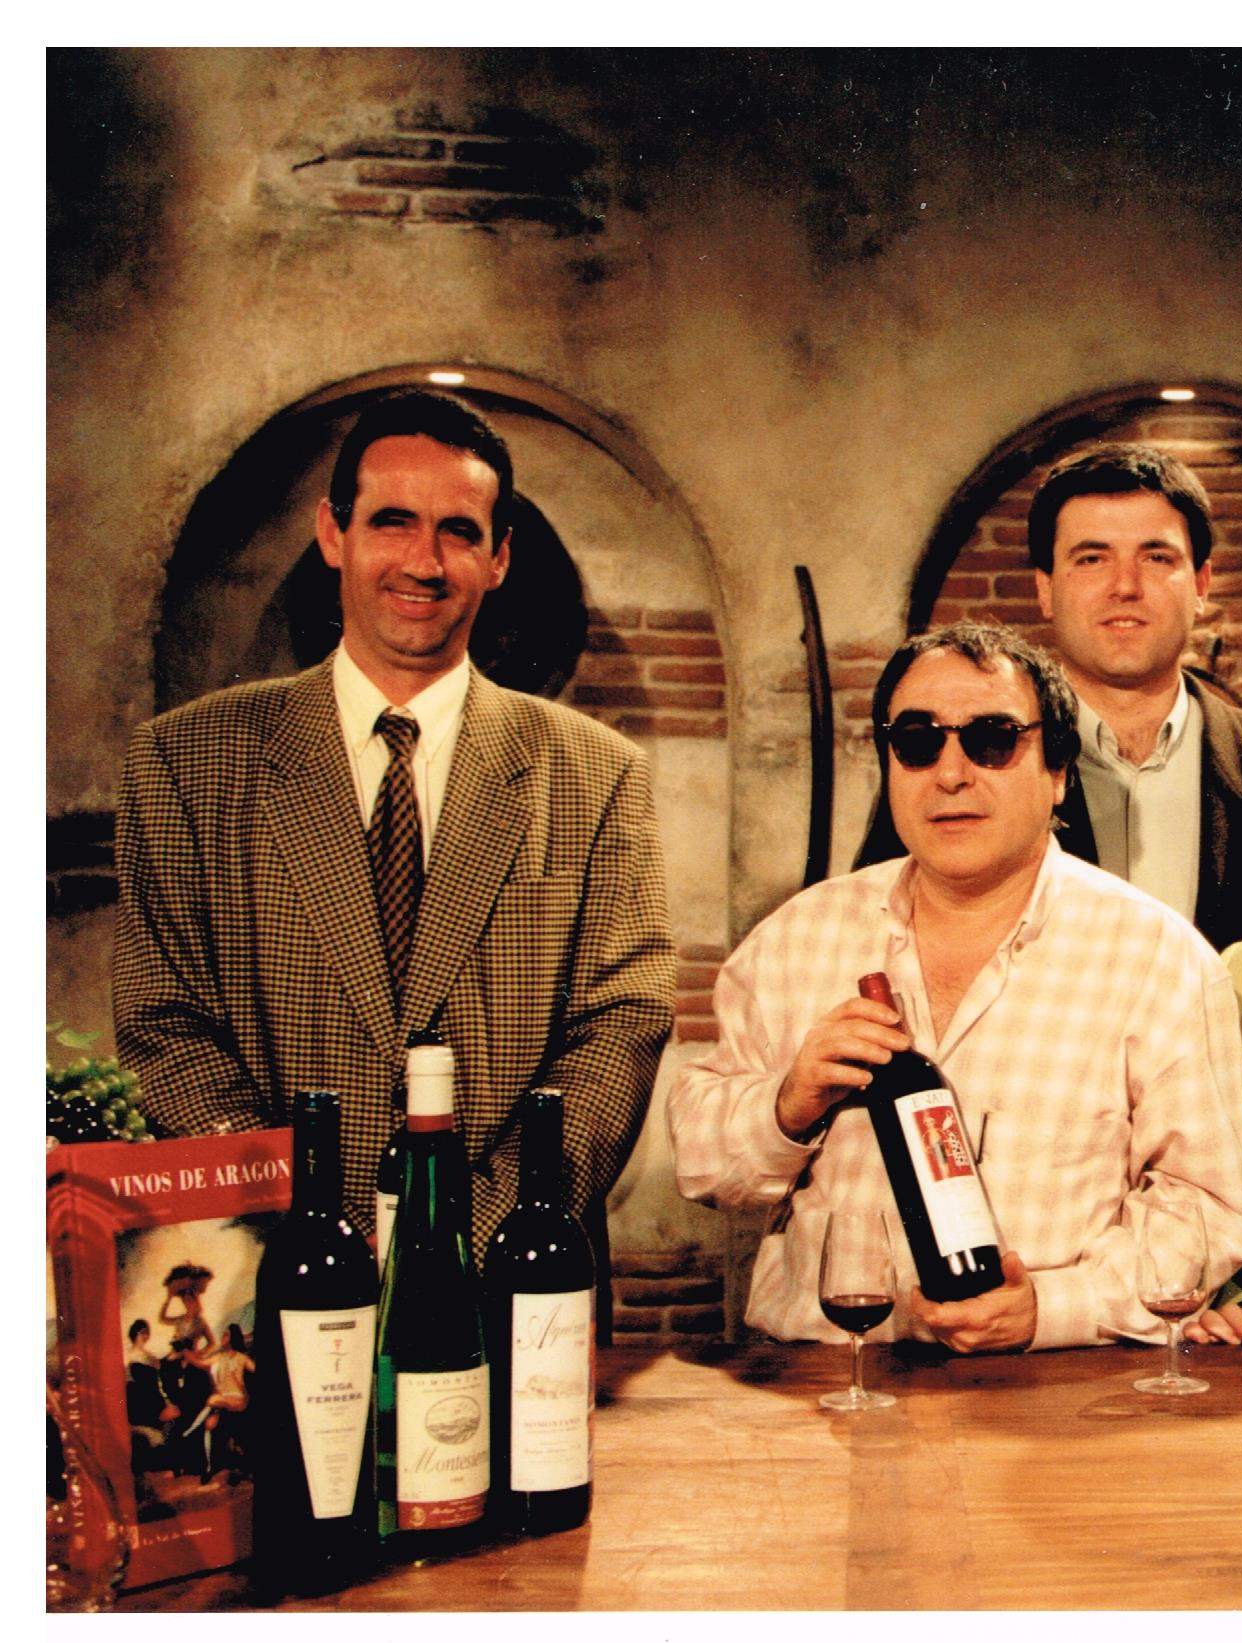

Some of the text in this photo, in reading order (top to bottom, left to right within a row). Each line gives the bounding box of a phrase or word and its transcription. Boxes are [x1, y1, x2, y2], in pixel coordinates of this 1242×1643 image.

[109, 1158, 291, 1198] VINOS DE ARAGON
[320, 1382, 353, 1391] VEGA
